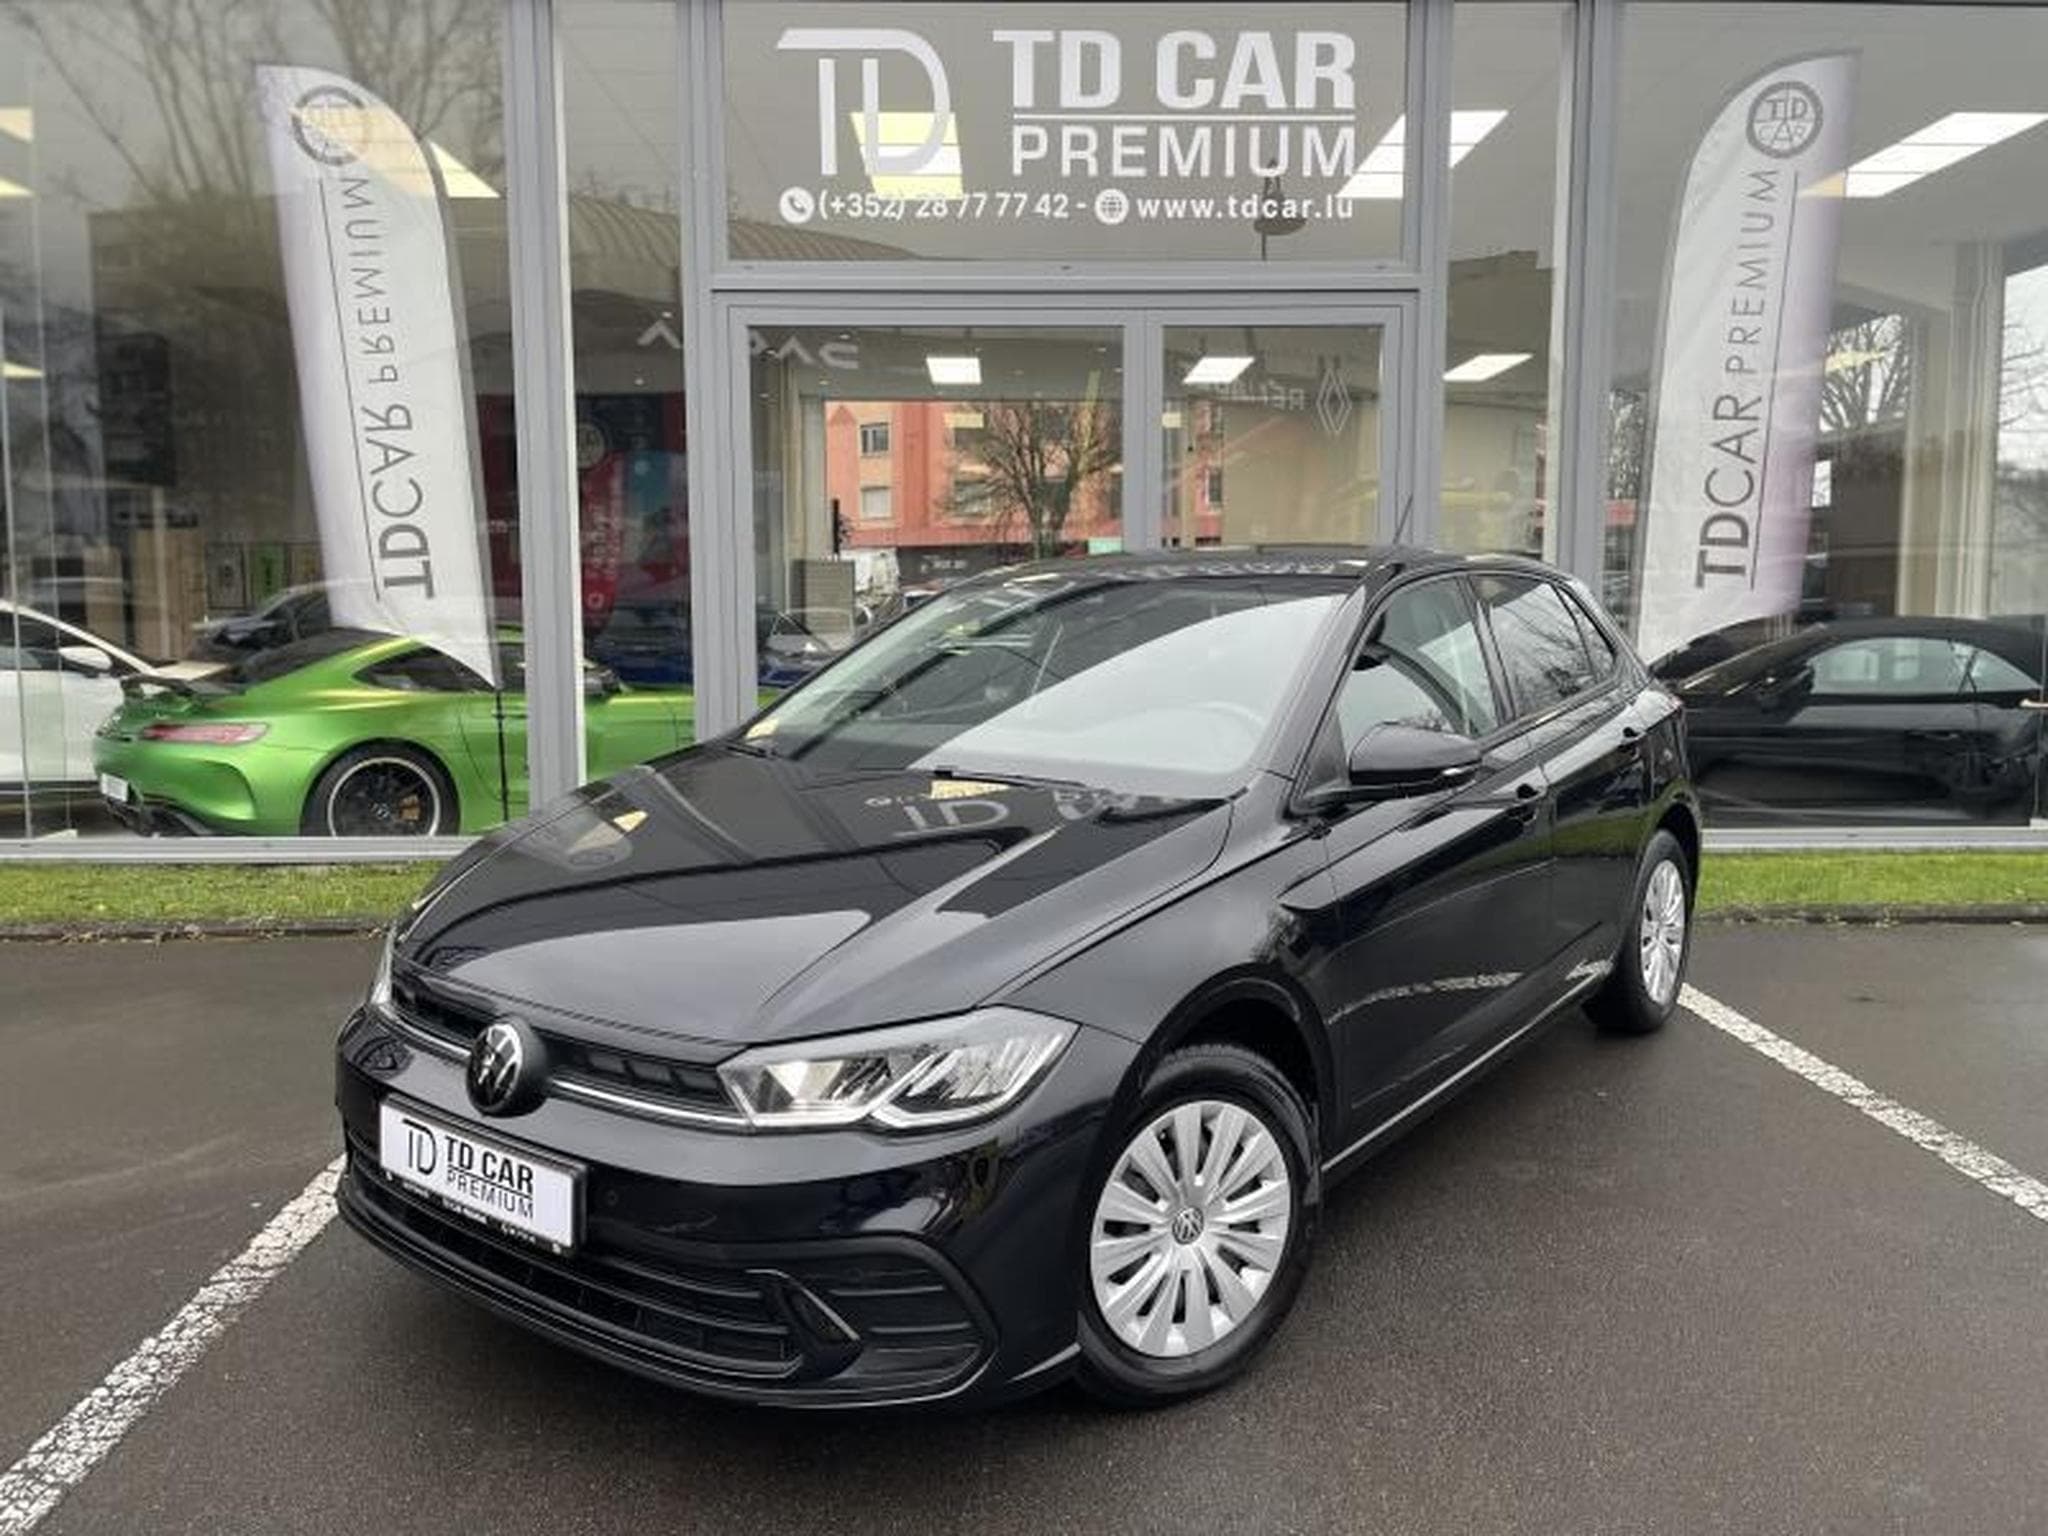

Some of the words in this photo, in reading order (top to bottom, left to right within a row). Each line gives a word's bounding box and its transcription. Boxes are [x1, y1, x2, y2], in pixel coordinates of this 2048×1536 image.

[993, 30, 1121, 108] TD
[1156, 30, 1355, 109] CAR
[1012, 124, 1355, 177] PREMIUM
[818, 190, 906, 220] (+352)
[915, 194, 949, 219] 28
[957, 193, 987, 219] 77
[996, 193, 1028, 219] 77
[1034, 193, 1069, 219] 42
[1136, 194, 1354, 219] www.tdcar.lu
[1725, 170, 1779, 375] PREMIUM
[1695, 395, 1763, 589] TDCAR
[444, 1135, 474, 1170] TD
[481, 1150, 533, 1196] CAR
[447, 1168, 533, 1219] PREMIUM
